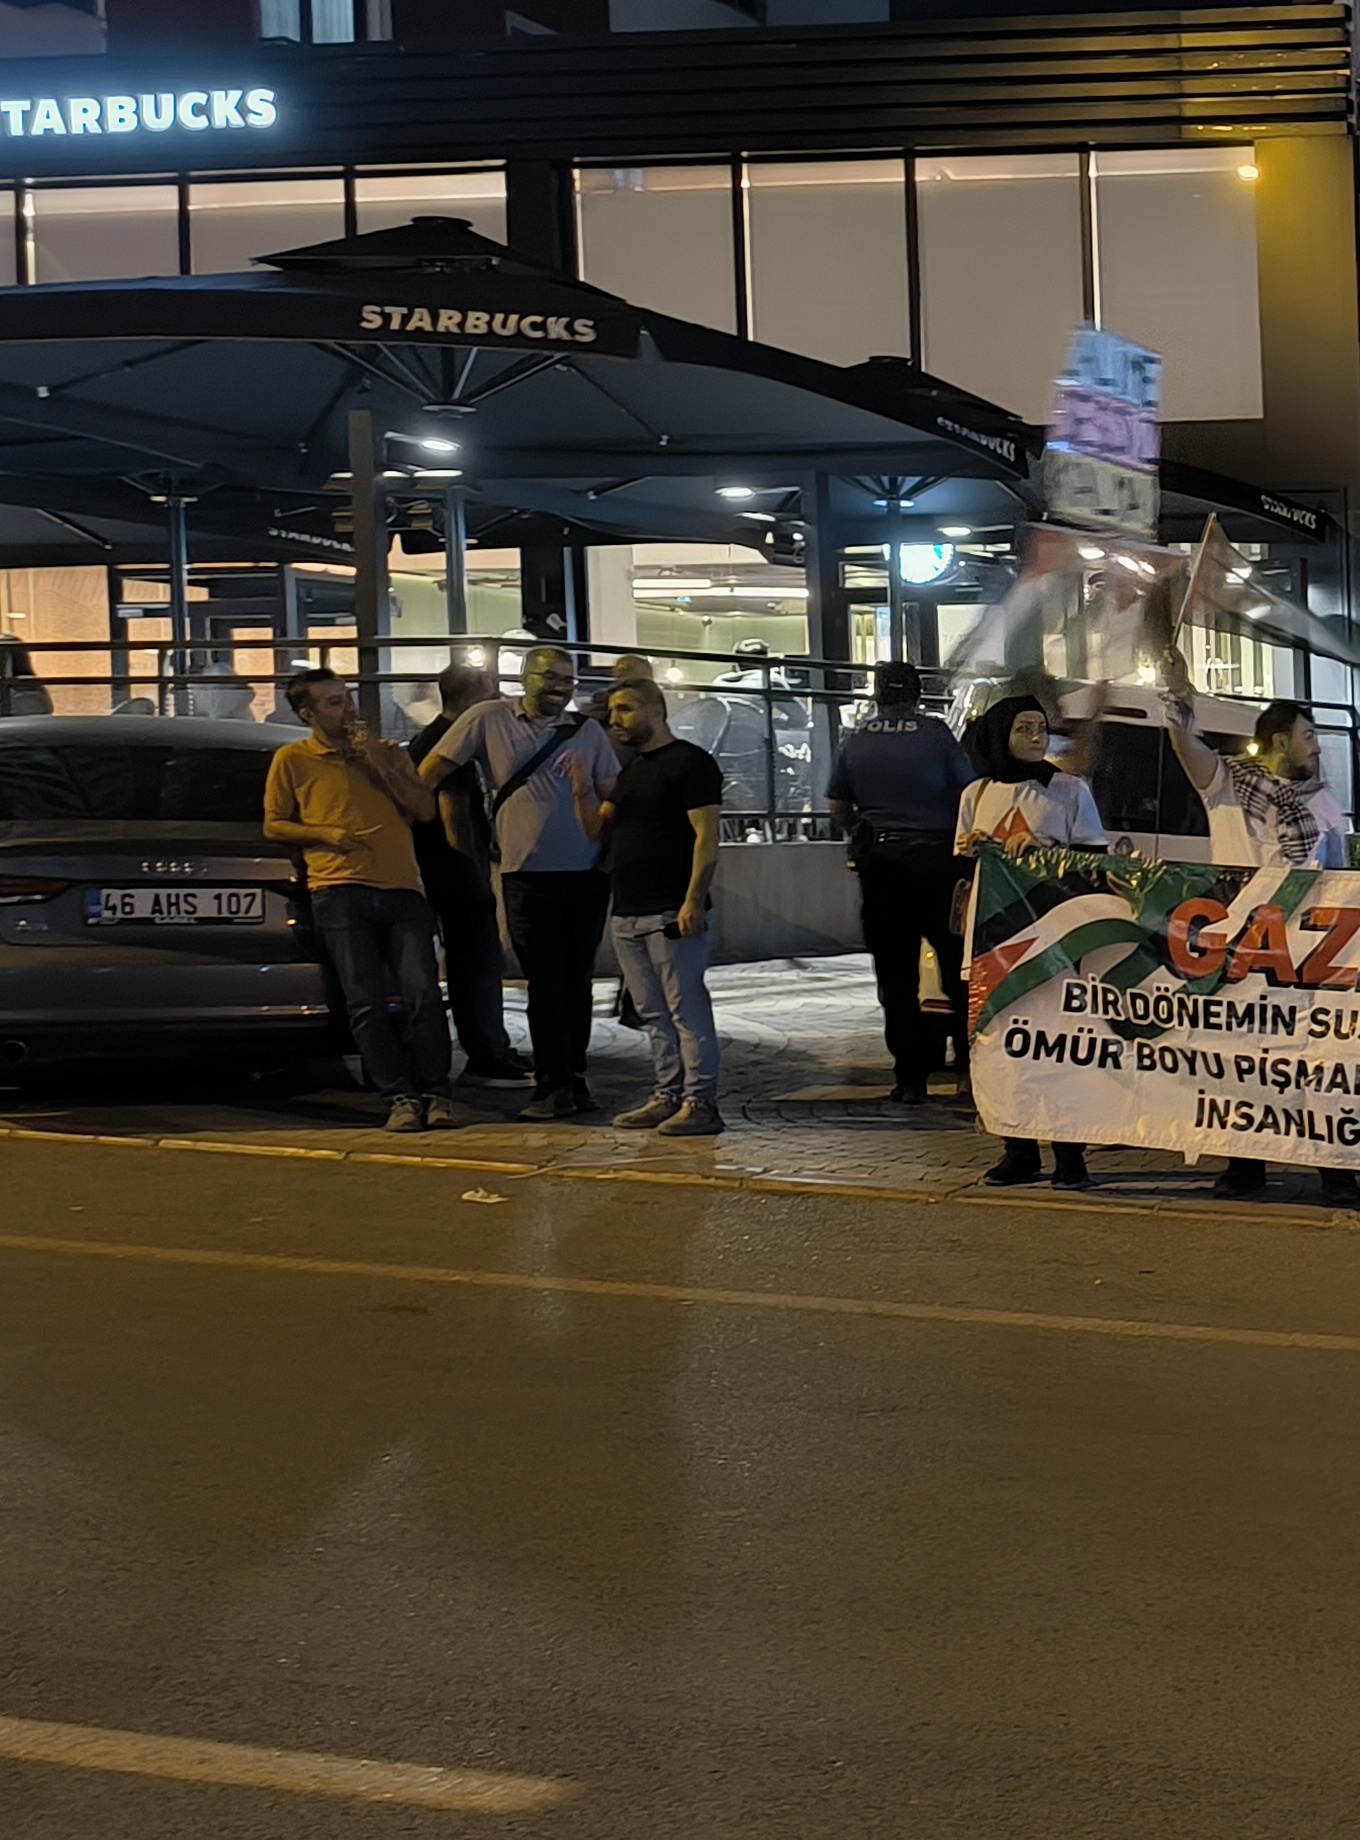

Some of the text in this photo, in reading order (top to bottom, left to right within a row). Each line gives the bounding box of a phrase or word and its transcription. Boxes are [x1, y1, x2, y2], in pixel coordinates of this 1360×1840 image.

[0, 88, 278, 136] TARBUCKS
[360, 305, 597, 342] STARBUCKS
[103, 893, 257, 916] 46 AHS 107
[1062, 975, 1122, 1020] BİR
[1129, 985, 1297, 1037] DÖNEMİN
[1005, 1018, 1124, 1070] ÖMÜR
[1136, 1041, 1225, 1079] BOYU
